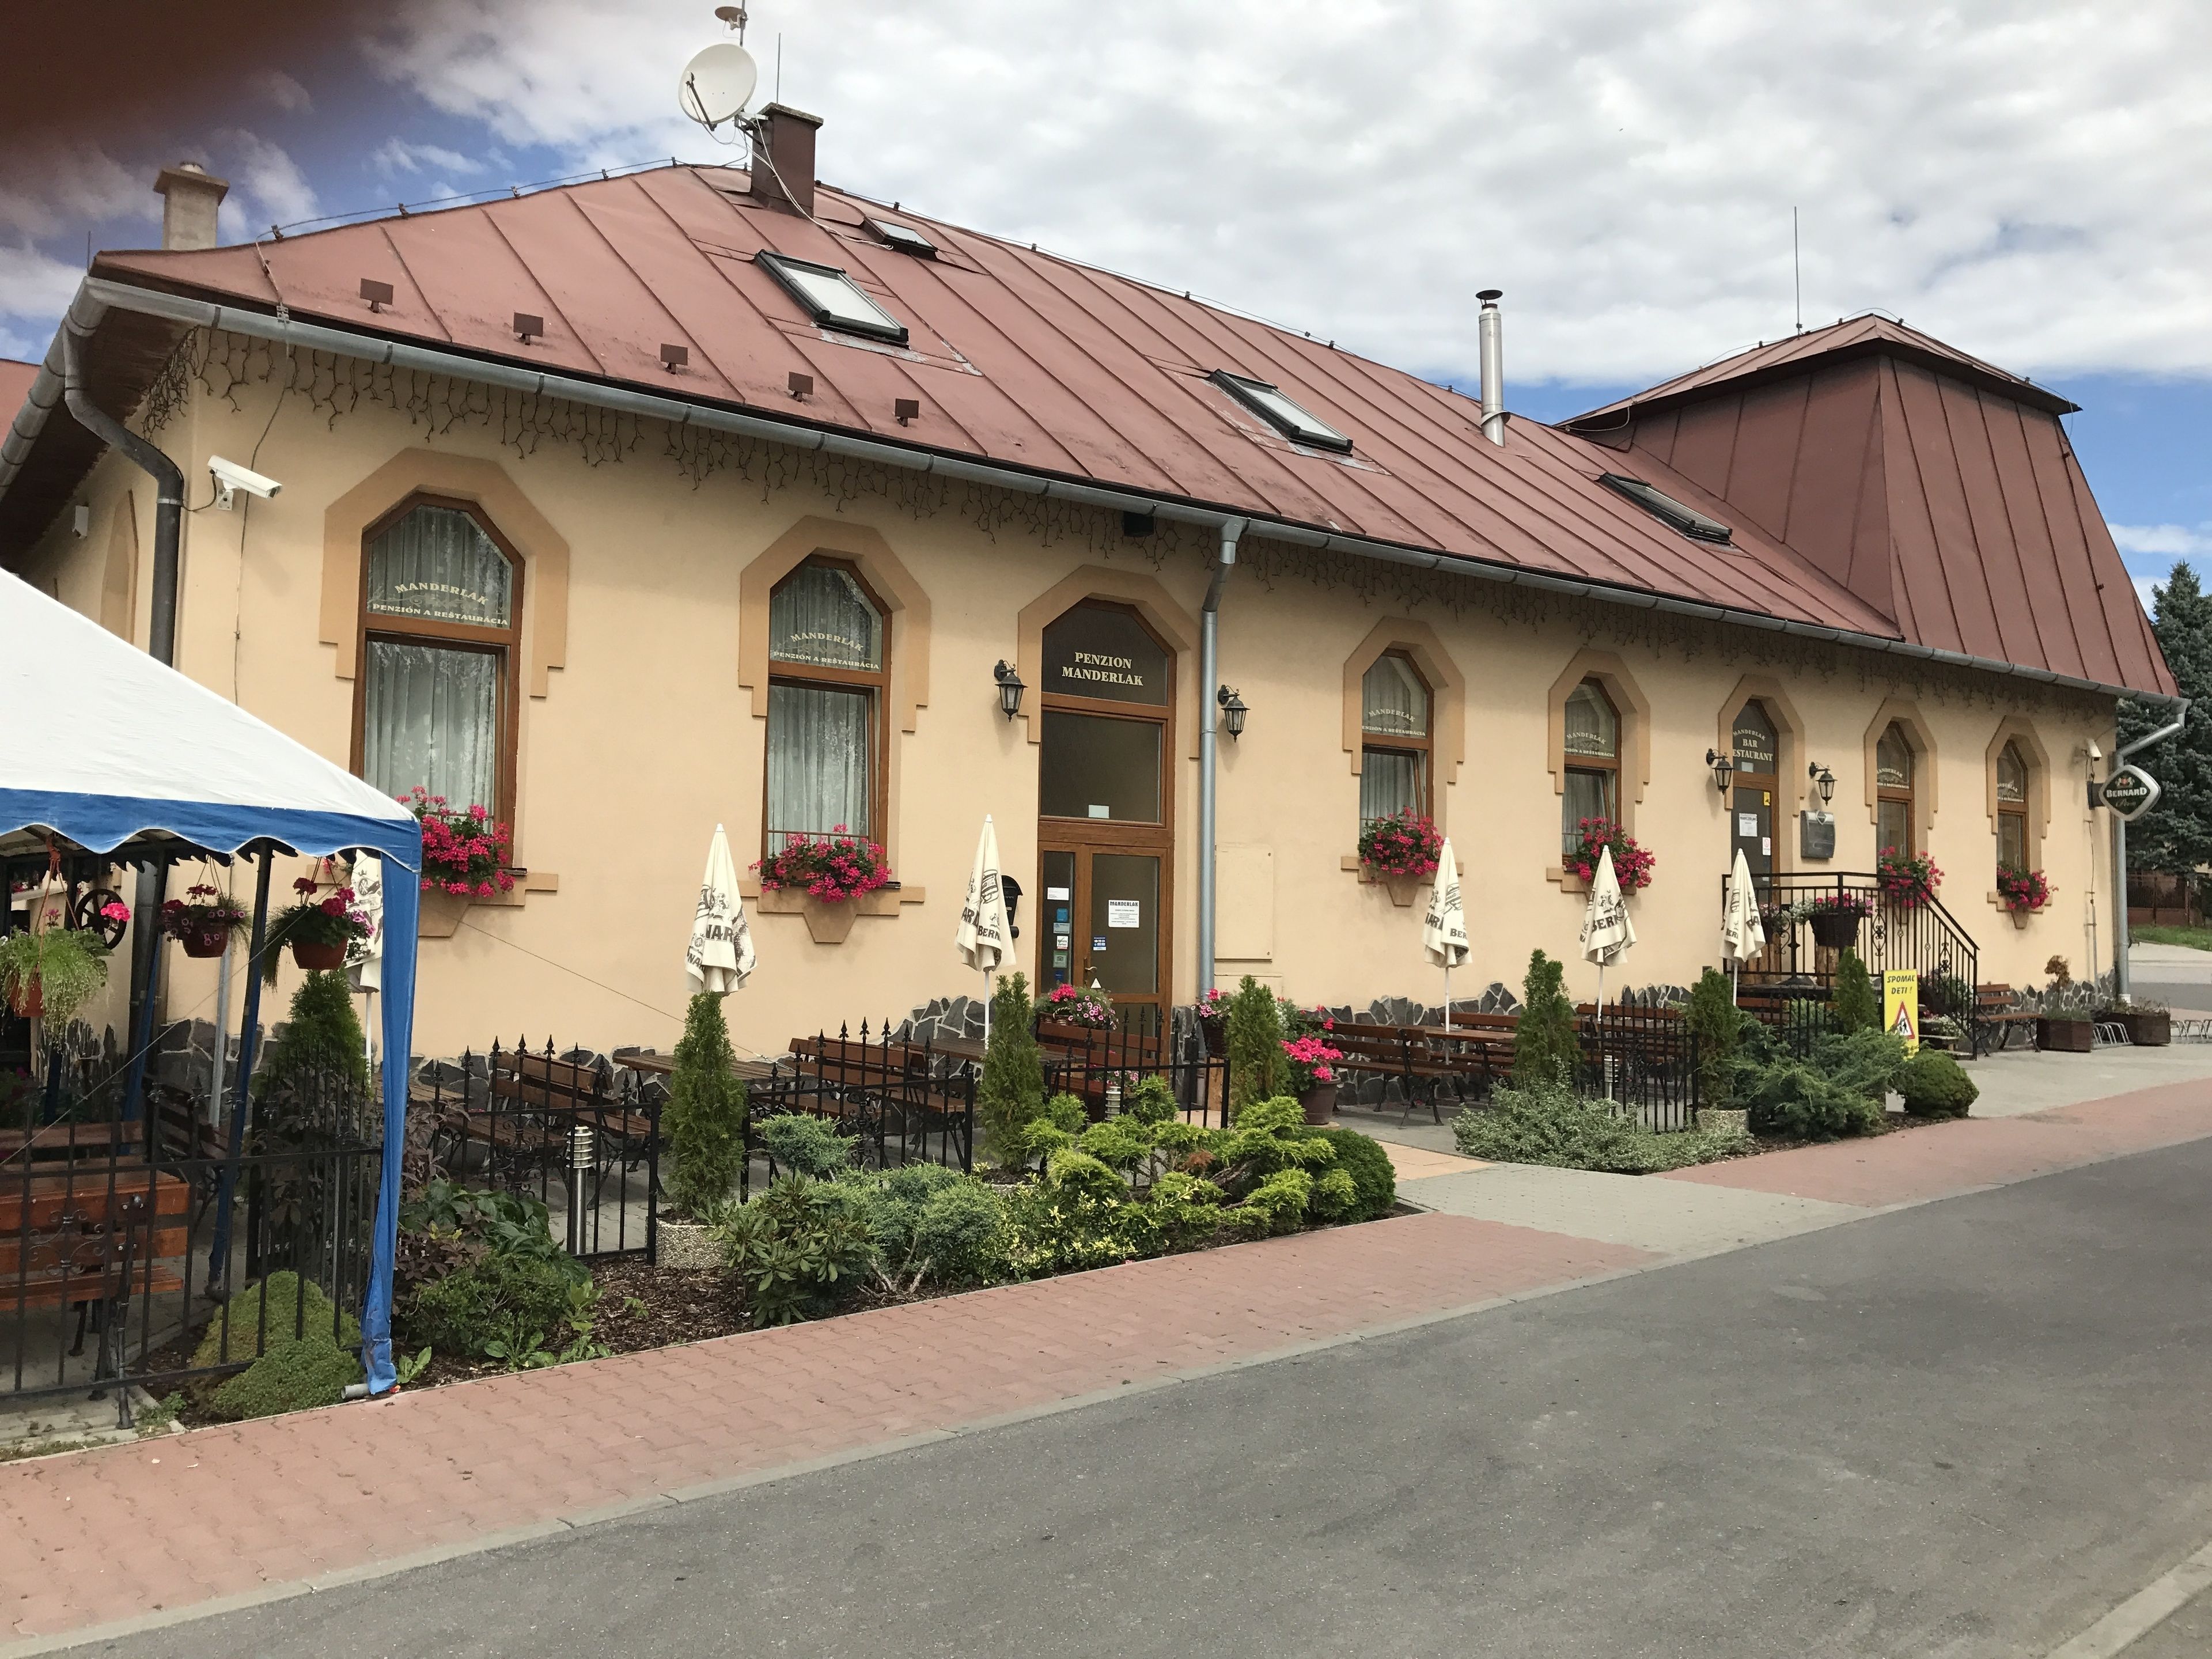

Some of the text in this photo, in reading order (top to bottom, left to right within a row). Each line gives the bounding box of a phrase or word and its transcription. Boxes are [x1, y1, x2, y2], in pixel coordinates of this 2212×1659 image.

[395, 582, 488, 605] MANDERLAK
[373, 604, 421, 615] PENZIÓN
[790, 632, 864, 652] MANDERLAK
[774, 651, 811, 661] PENZIÓN
[1075, 652, 1132, 669] PENZION
[1062, 666, 1144, 686] MANDERLAK
[1368, 709, 1415, 722] MANDERLAK
[1566, 732, 1607, 745] MANDERLAK
[1733, 729, 1766, 741] MANDERLAK
[1743, 738, 1758, 748] BAR
[1732, 749, 1773, 762] ESTAURANT
[2106, 787, 2147, 798] BERNARD
[1891, 987, 1907, 995] DETI
